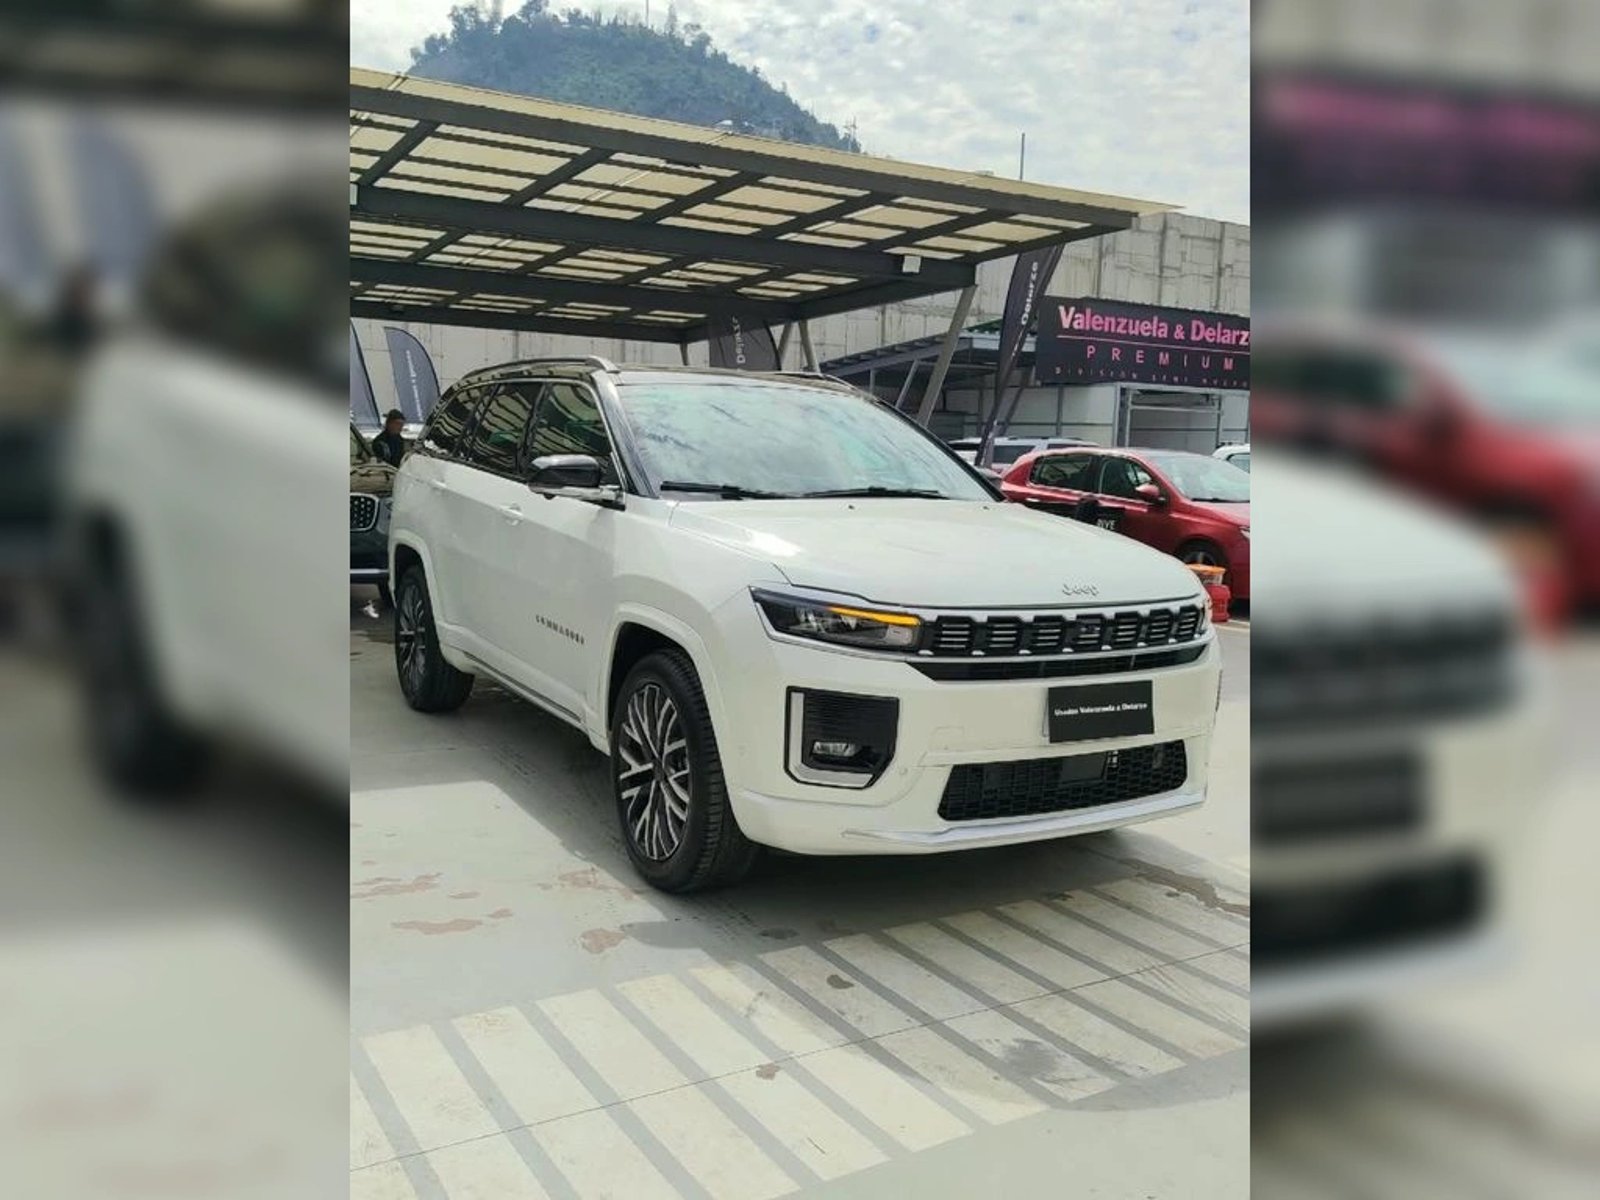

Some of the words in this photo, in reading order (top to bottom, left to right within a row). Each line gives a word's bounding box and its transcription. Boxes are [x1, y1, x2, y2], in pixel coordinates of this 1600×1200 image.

[1058, 305, 1168, 338] Valenzuela
[1174, 324, 1185, 340] &
[1086, 344, 1233, 370] PREMIUM
[1062, 584, 1099, 596] Jeep
